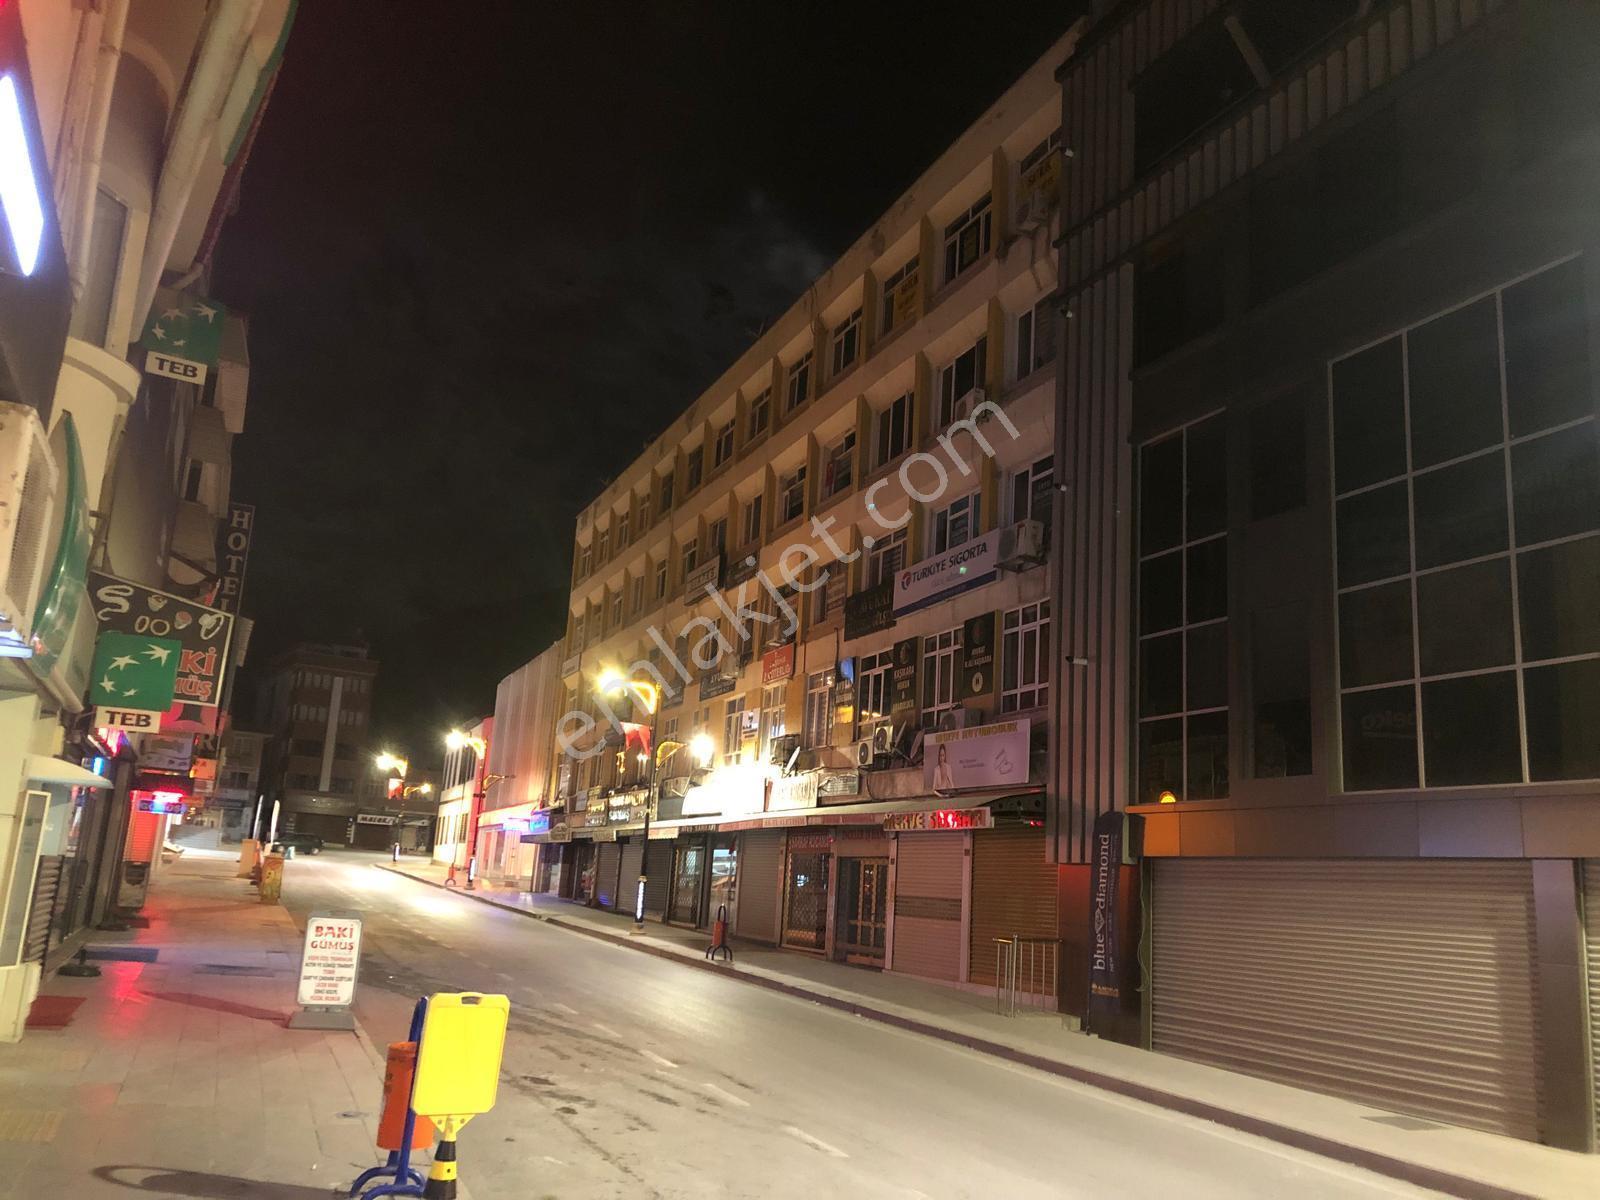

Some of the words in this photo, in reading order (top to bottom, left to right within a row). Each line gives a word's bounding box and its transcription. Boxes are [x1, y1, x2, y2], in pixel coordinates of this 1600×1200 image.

[155, 356, 199, 378] TEB
[178, 646, 218, 676] Kİ
[105, 710, 151, 728] TEB
[1096, 834, 1110, 910] diamond
[314, 923, 354, 939] BAKİ
[1093, 933, 1106, 971] blue
